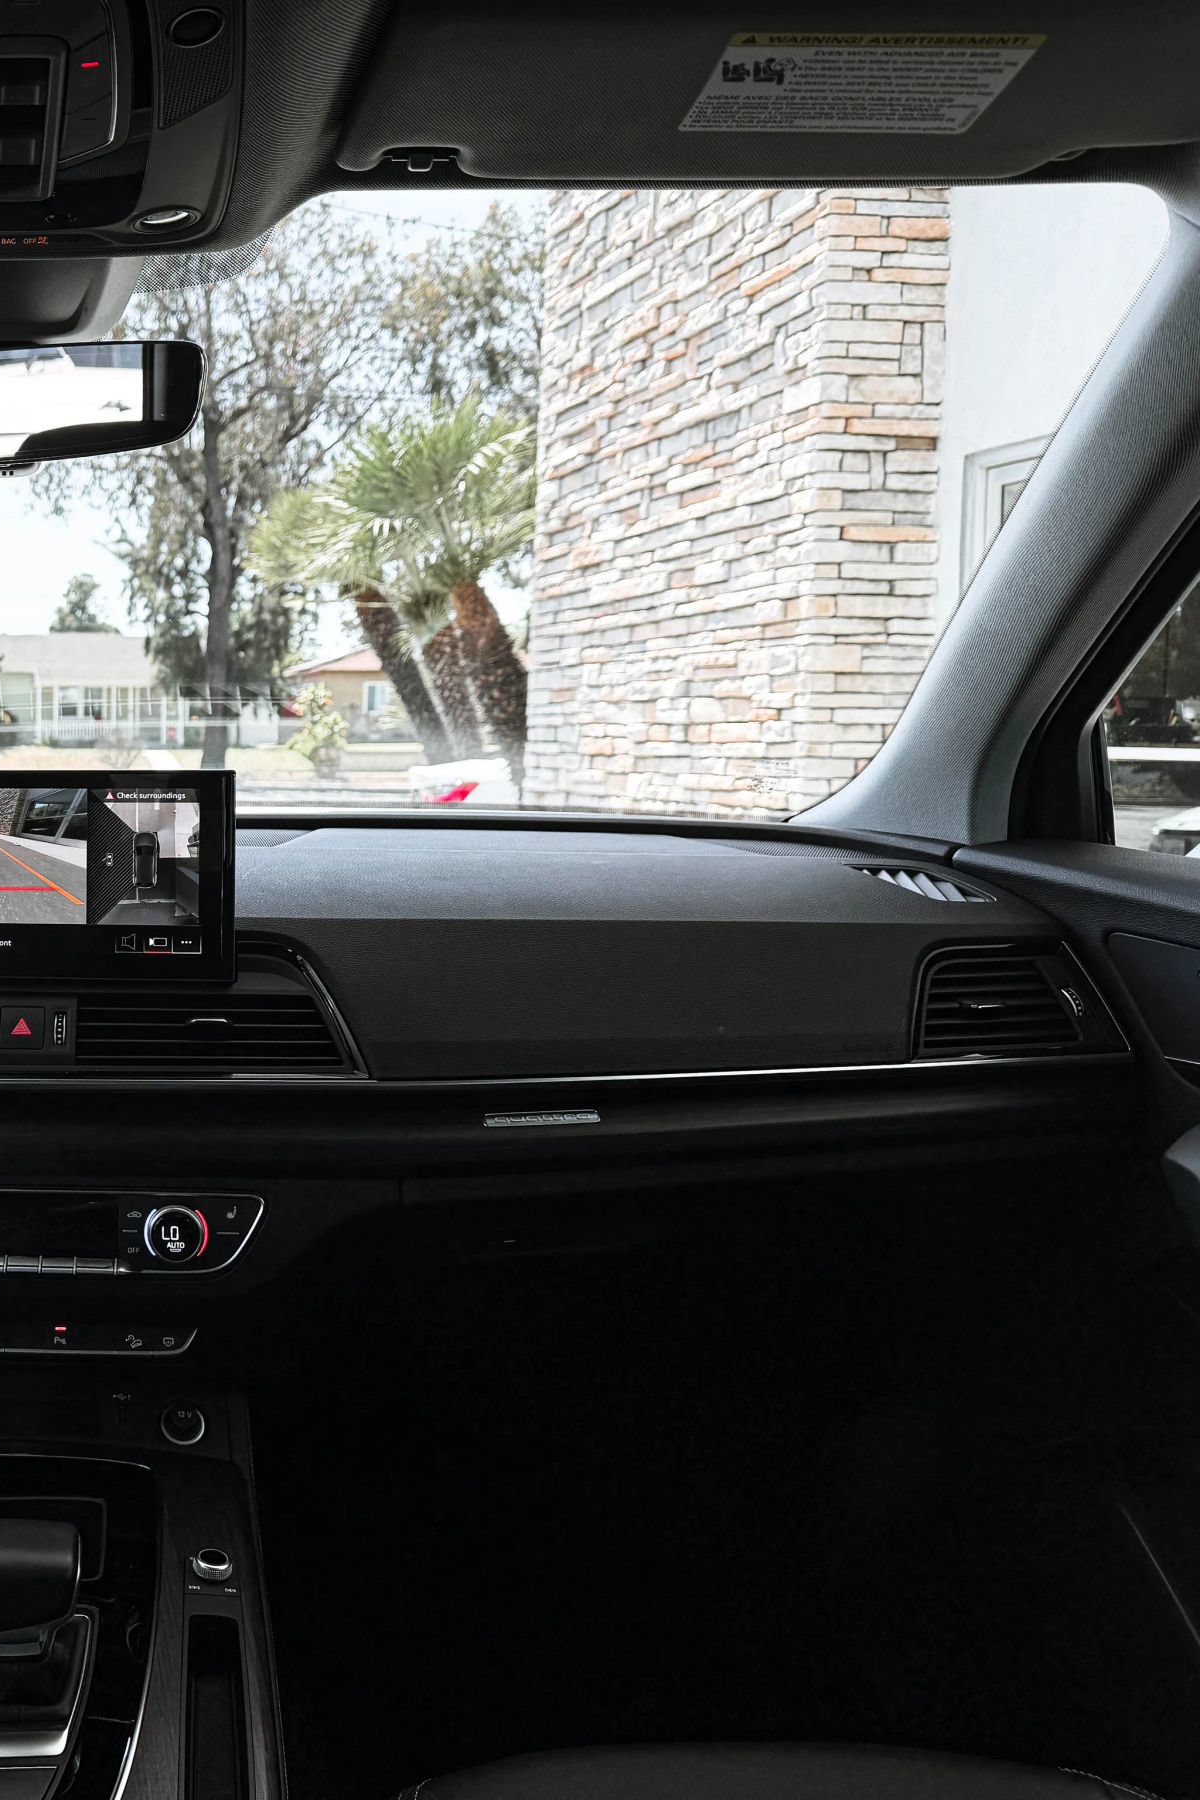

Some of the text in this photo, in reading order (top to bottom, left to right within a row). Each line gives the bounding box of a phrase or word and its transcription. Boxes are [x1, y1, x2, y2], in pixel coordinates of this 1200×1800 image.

[769, 35, 1029, 45] WARNING! AVERTISSEMENT!
[139, 792, 186, 800] surroundings
[161, 1225, 180, 1241] LO
[177, 1410, 192, 1419] 12 V
